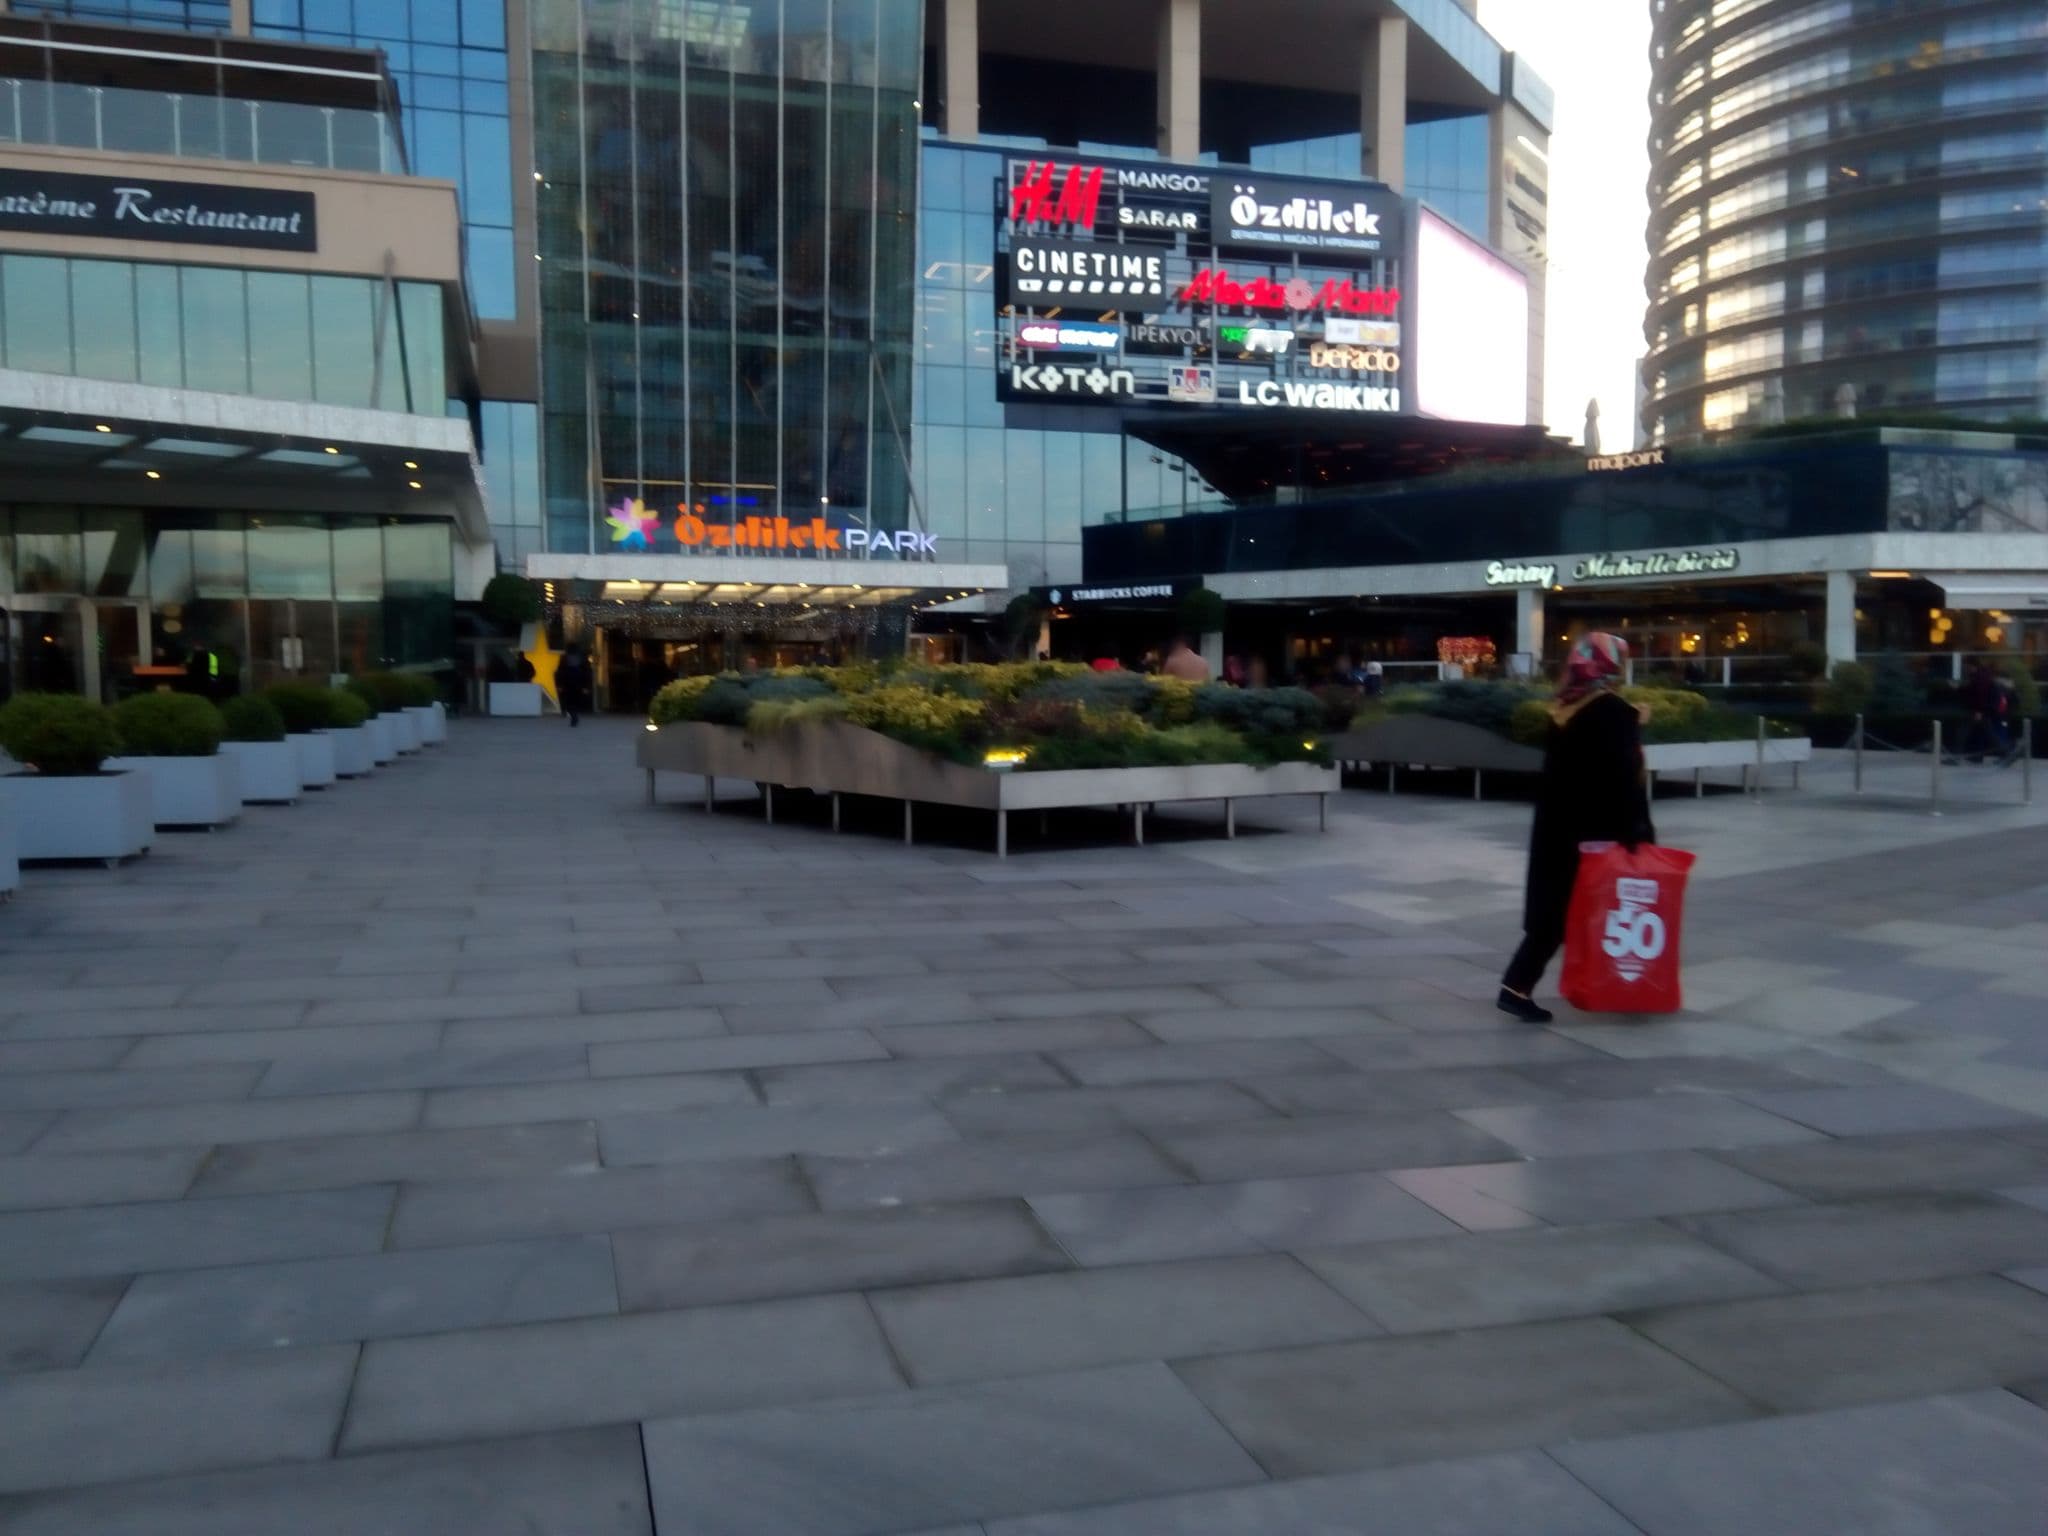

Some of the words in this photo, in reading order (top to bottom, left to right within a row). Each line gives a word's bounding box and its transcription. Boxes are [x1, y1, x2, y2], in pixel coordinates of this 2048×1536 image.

[1118, 170, 1201, 192] MANGO
[113, 187, 301, 234] Restaurant
[1118, 207, 1198, 230] SARAR
[1230, 184, 1381, 235] Özdilek
[1017, 247, 1161, 281] CINETIME
[1239, 380, 1280, 406] LC
[674, 502, 841, 550] Özdilek
[844, 527, 939, 554] PARK
[1486, 560, 1557, 590] Saray
[1602, 910, 1667, 960] 50
